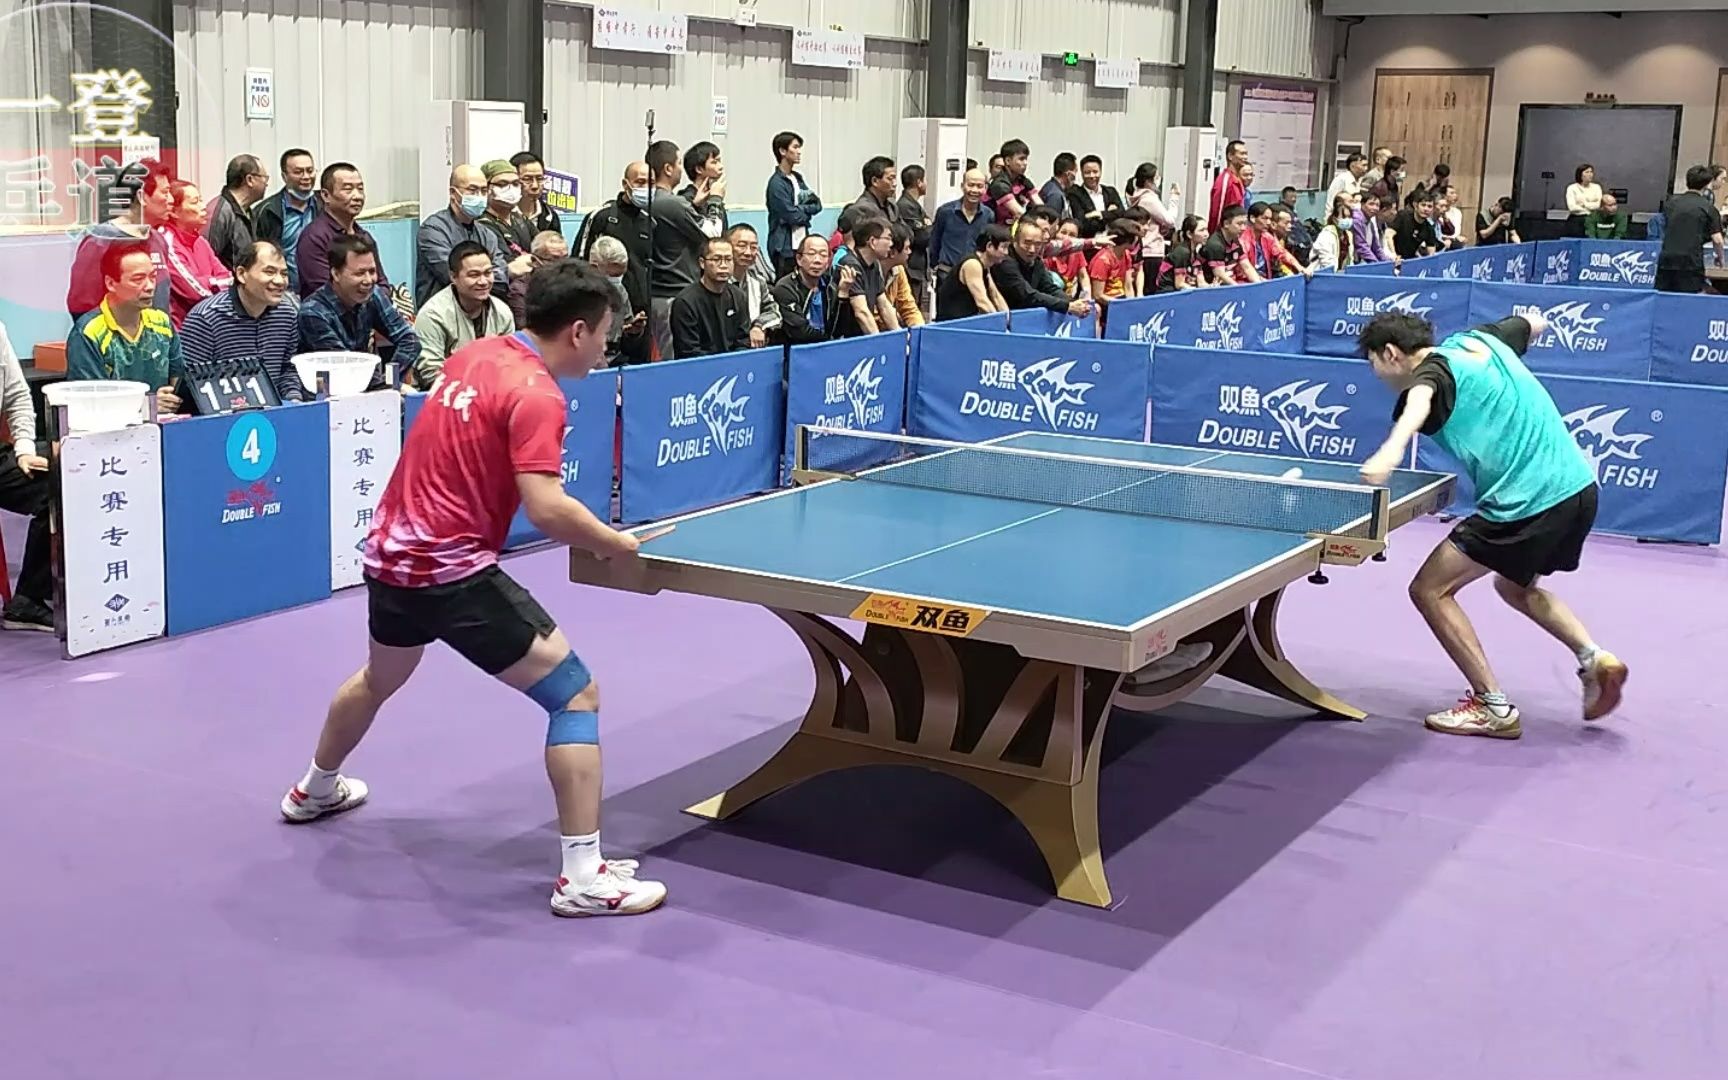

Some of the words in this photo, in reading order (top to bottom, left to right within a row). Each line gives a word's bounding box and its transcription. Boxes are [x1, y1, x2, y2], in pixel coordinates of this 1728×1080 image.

[1579, 268, 1620, 282] DOUBLE
[1633, 274, 1655, 284] FISH
[1346, 296, 1375, 317] 双魚
[1574, 336, 1608, 351] FISH
[979, 360, 1017, 390] 双魚
[200, 381, 220, 410] 1
[245, 376, 266, 405] 1
[1219, 385, 1260, 416] 双魚
[670, 393, 698, 428] 双魚
[864, 403, 884, 426] FISH
[960, 391, 1035, 422] DOUBLE
[1057, 409, 1099, 431] FISH
[242, 427, 261, 465] 4
[657, 436, 712, 467] DOUBLE
[727, 426, 754, 451] FISH
[1198, 419, 1283, 450] DOUBLE
[1309, 435, 1356, 456] FISH
[353, 417, 375, 529] 比赛专用
[1602, 464, 1659, 489] FISH
[99, 456, 129, 583] 比赛专用
[222, 506, 255, 524] DOUBLE
[262, 502, 281, 516] FISH
[910, 605, 970, 633] 双鱼
